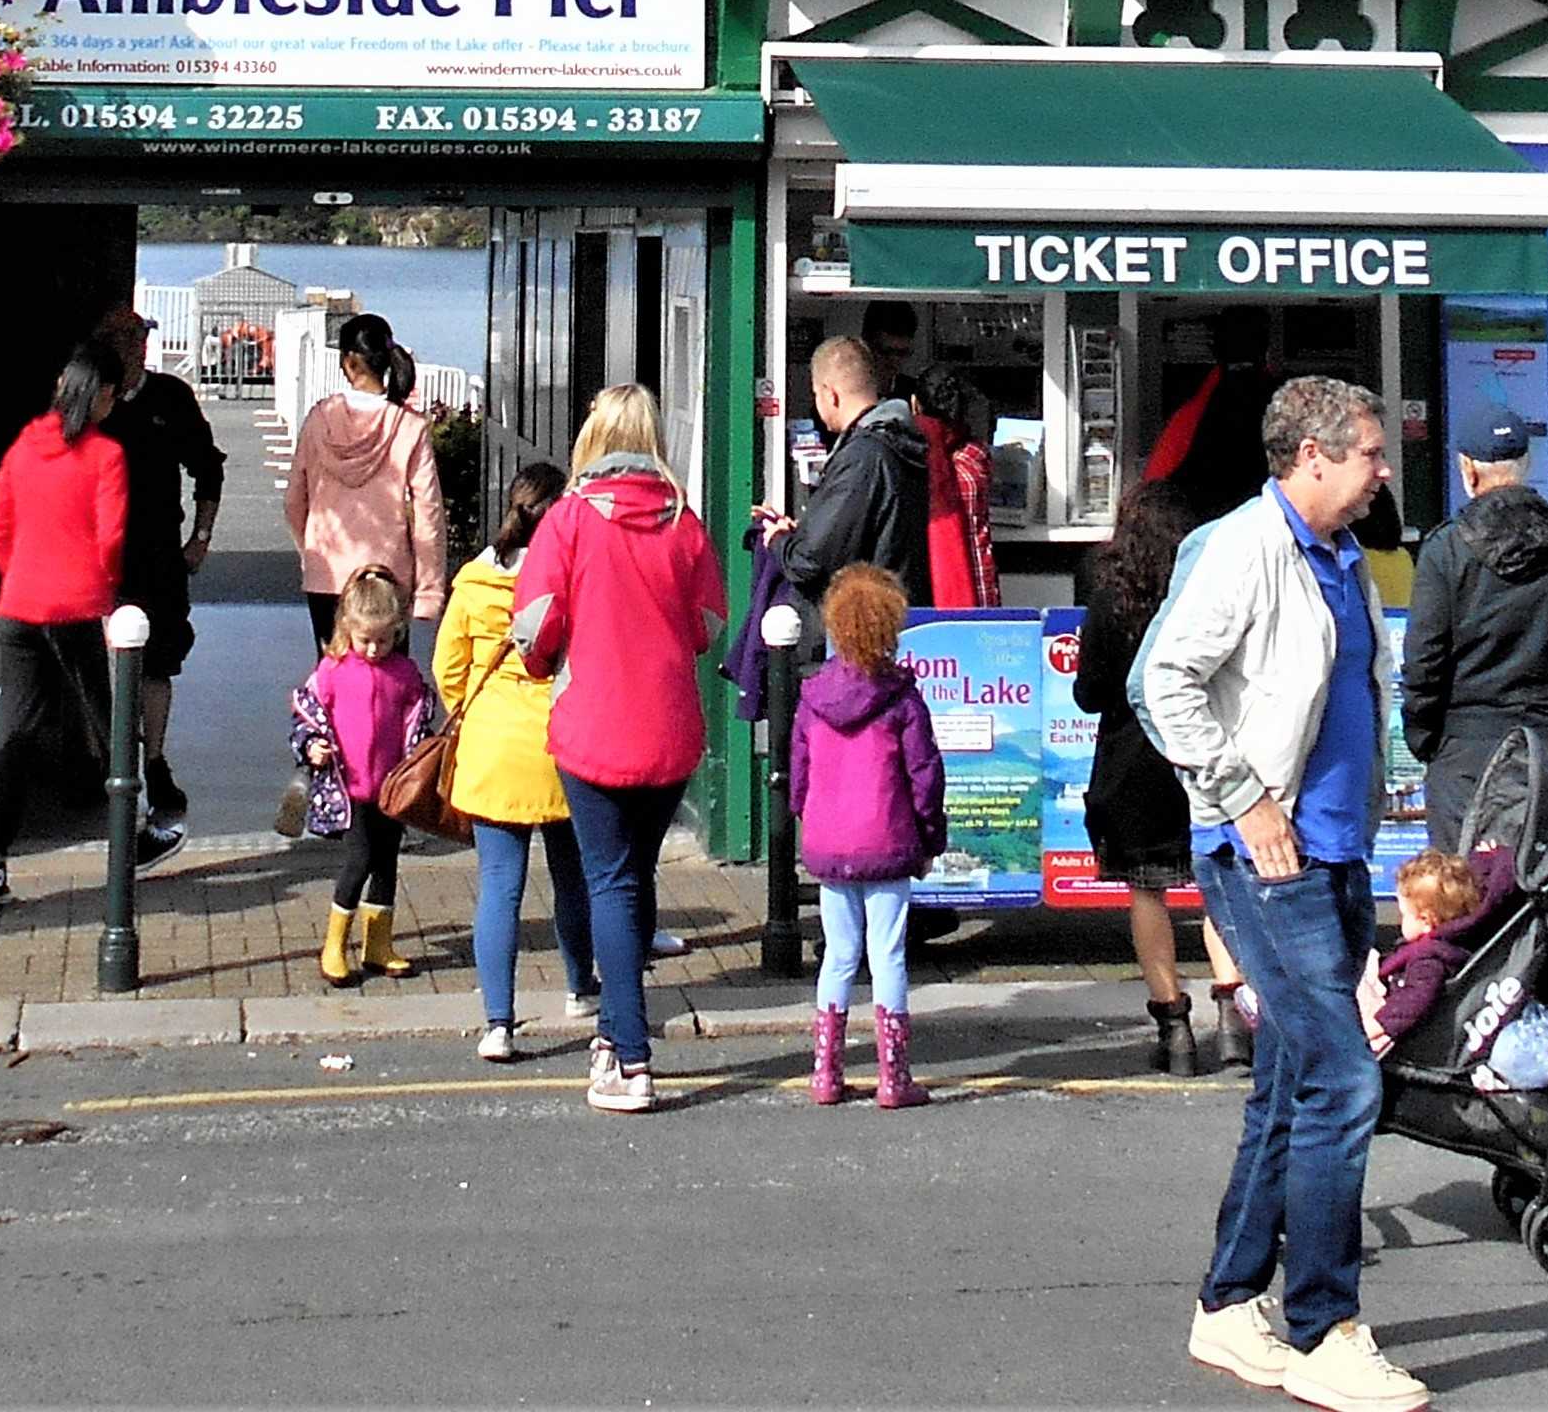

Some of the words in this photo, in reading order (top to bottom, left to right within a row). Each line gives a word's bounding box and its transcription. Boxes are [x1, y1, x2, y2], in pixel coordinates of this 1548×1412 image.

[51, 35, 78, 49] 364
[82, 35, 114, 52] days
[118, 39, 126, 49] a
[130, 35, 166, 52] year!
[169, 35, 195, 50] Ask
[199, 36, 238, 51] about
[243, 39, 264, 50] our
[270, 38, 304, 52] great
[310, 37, 344, 50] value
[350, 37, 408, 51] Freedom
[413, 36, 427, 50] of
[431, 37, 451, 51] the
[456, 38, 486, 52] Lake
[493, 38, 523, 52] offer
[538, 39, 581, 52] Please
[587, 39, 613, 53] take
[619, 43, 627, 53] a
[77, 60, 170, 74] Information:
[176, 60, 228, 74] 015394
[234, 61, 277, 74] 43360
[427, 62, 682, 77] www.windermere-lakecruises.co.uk
[62, 104, 176, 129] 015394
[207, 104, 303, 130] 32225
[375, 105, 453, 130] FAX.
[463, 106, 576, 131] 015394
[607, 107, 701, 132] 33187
[143, 141, 532, 156] www.windermere-lakecruises.co.uk
[974, 235, 1187, 283] TICKET
[1218, 236, 1430, 285] OFFICE
[932, 684, 959, 701] the
[963, 675, 1031, 705] Lake
[1049, 719, 1067, 730] 30
[1071, 718, 1097, 730] Min
[1050, 732, 1084, 743] Each
